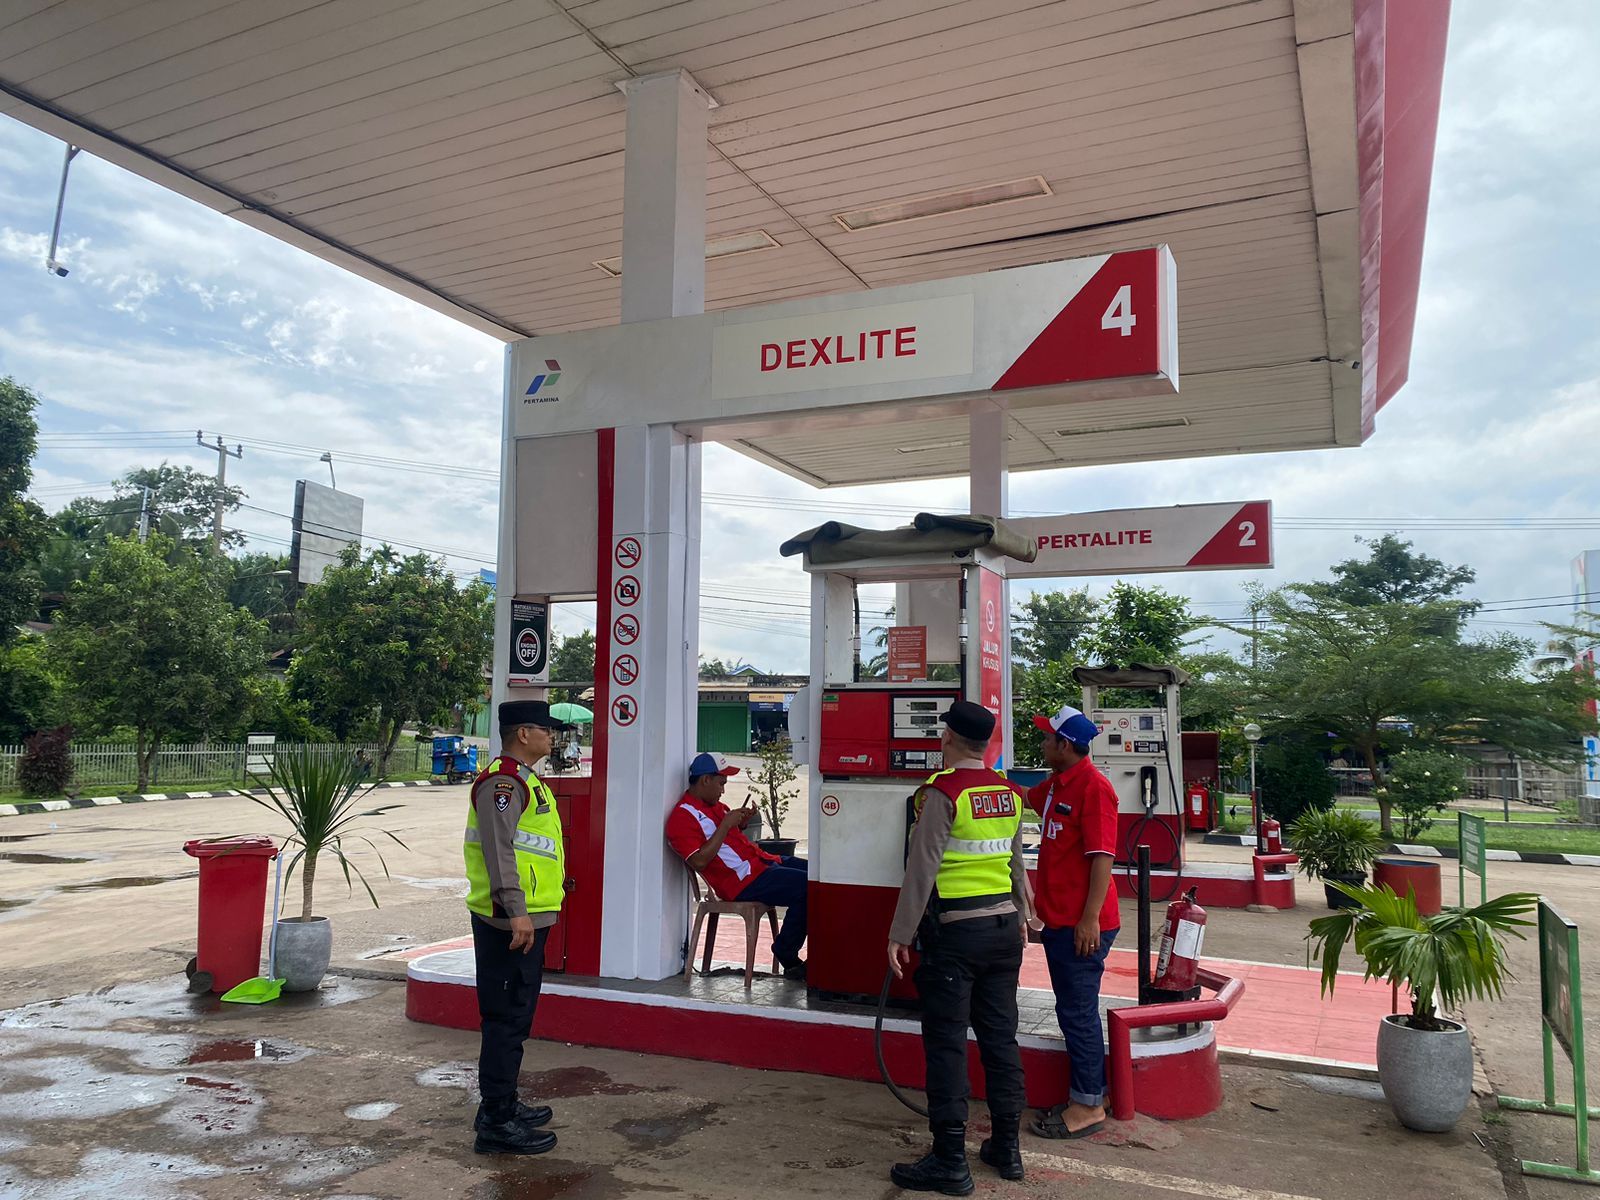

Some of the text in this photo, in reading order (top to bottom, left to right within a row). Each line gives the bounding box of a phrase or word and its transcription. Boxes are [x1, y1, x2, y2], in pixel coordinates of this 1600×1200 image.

[1101, 284, 1137, 337] 4
[760, 326, 917, 372] DEXLITE
[523, 396, 560, 405] PERTAMINA
[1037, 529, 1153, 550] PERTALITE
[1237, 520, 1257, 548] 2
[520, 648, 537, 658] OFF
[823, 801, 837, 811] 4B
[972, 794, 1014, 814] POLISI
